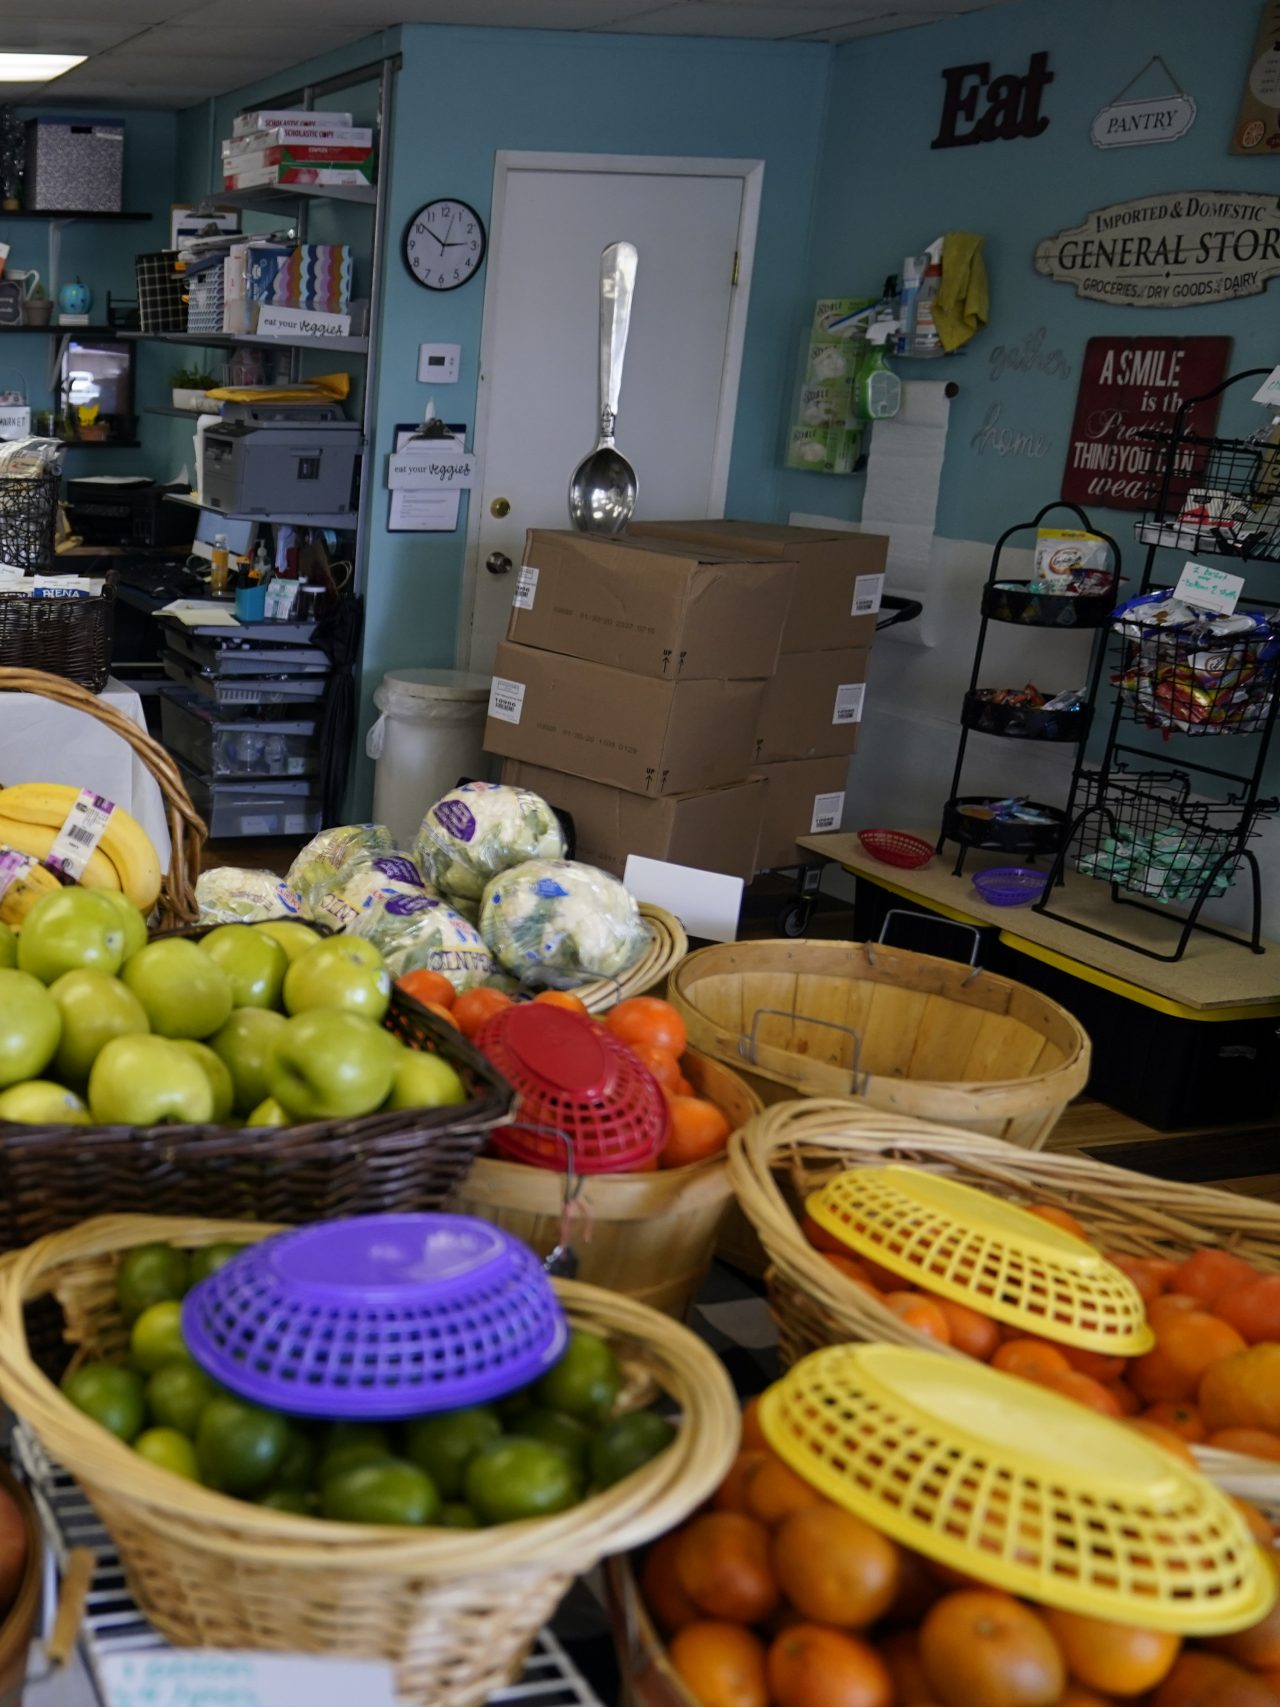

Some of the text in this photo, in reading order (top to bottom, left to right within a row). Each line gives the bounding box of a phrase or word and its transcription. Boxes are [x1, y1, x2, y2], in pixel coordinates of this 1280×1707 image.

[930, 51, 1054, 149] Eat
[284, 129, 318, 138] SCHOLASTIC
[1106, 109, 1179, 135] PANTRY
[1095, 197, 1267, 233] IMPORTED & DOMESTIC
[1057, 234, 1188, 270] GENERAL
[1147, 285, 1170, 299] DRY
[1223, 271, 1259, 291] DAIRY
[279, 320, 298, 329] your
[988, 326, 1072, 382] gather
[1098, 350, 1185, 387] A SMILE
[1140, 391, 1157, 412] is
[970, 401, 1050, 458] home
[408, 465, 427, 475] your
[1073, 442, 1117, 472] THING
